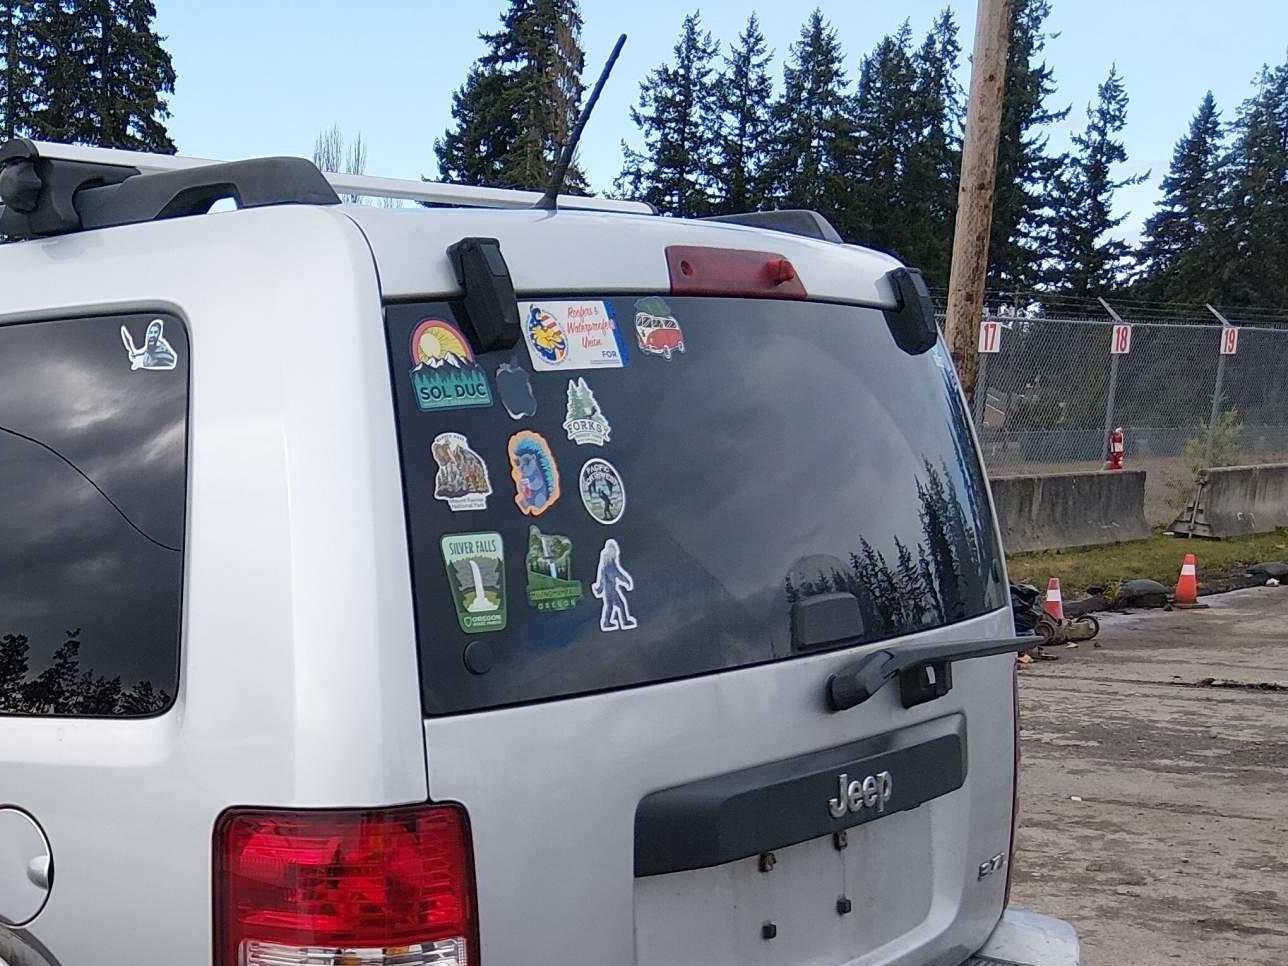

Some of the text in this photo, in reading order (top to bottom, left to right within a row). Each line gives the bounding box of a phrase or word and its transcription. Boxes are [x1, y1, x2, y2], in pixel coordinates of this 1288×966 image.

[567, 306, 593, 322] Roofers
[582, 336, 601, 349] Union
[984, 324, 997, 351] 17
[1116, 327, 1128, 352] 18
[1224, 329, 1236, 353] 19
[602, 350, 617, 358] FOR
[420, 383, 487, 400] SOL DUC
[567, 420, 603, 434] FORKS
[449, 540, 497, 555] SILVER FALLS
[472, 614, 502, 622] OREGON
[829, 771, 893, 818] Jeep
